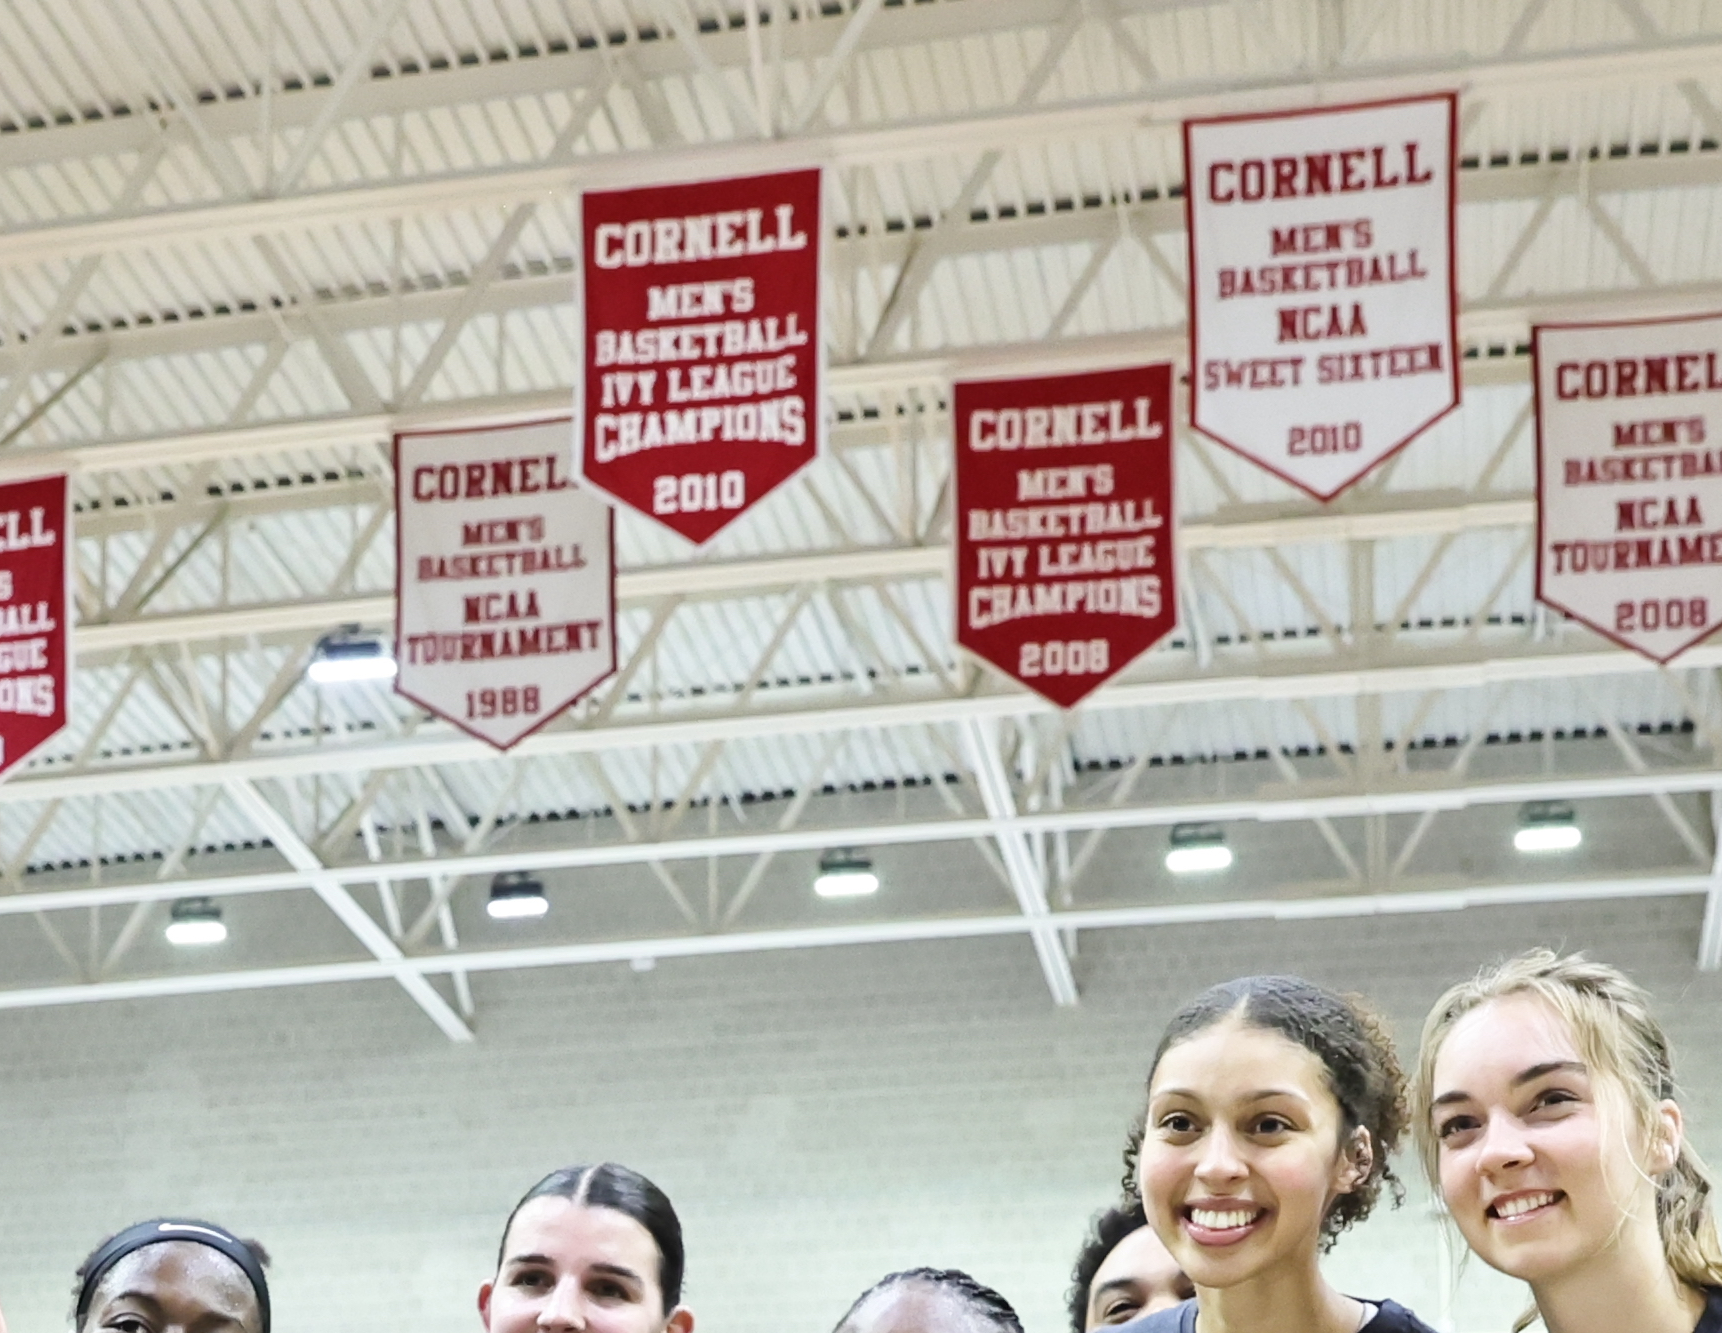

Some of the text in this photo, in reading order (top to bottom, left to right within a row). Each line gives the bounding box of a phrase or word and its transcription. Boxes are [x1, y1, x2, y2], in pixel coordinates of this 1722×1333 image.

[1209, 142, 1432, 205] CORNELL
[594, 204, 807, 269] CORNELL
[1270, 218, 1372, 258] MEN'S
[1218, 250, 1428, 299] BASKETBALL
[647, 278, 754, 322] MEN'S
[595, 314, 808, 366] BASKETBALL
[1277, 303, 1368, 343] NCAA
[601, 355, 797, 408] IVY LEAGUE
[1204, 342, 1443, 392] SWEET SIXTEEN
[593, 396, 806, 464] CHAMPIONS
[969, 398, 1163, 452] CORNELL
[1287, 422, 1362, 456] 2010
[1612, 415, 1706, 450] MEN'S
[412, 455, 577, 504] CORNEL
[653, 471, 746, 515] 2010
[1017, 464, 1114, 501] MEN'S
[461, 515, 546, 549] MEN'S
[968, 499, 1162, 541] BASKETBALL
[1615, 497, 1703, 532] NCAA
[417, 544, 586, 581] BASKETBALL
[977, 535, 1156, 580] IVY LEAGUE
[464, 590, 541, 624] NCAA
[968, 575, 1161, 631] CHAMPIONS
[1614, 598, 1708, 631] 2008
[407, 621, 602, 666] TOURNAMENT
[1019, 640, 1109, 677] 2008
[465, 685, 541, 720] 1988
